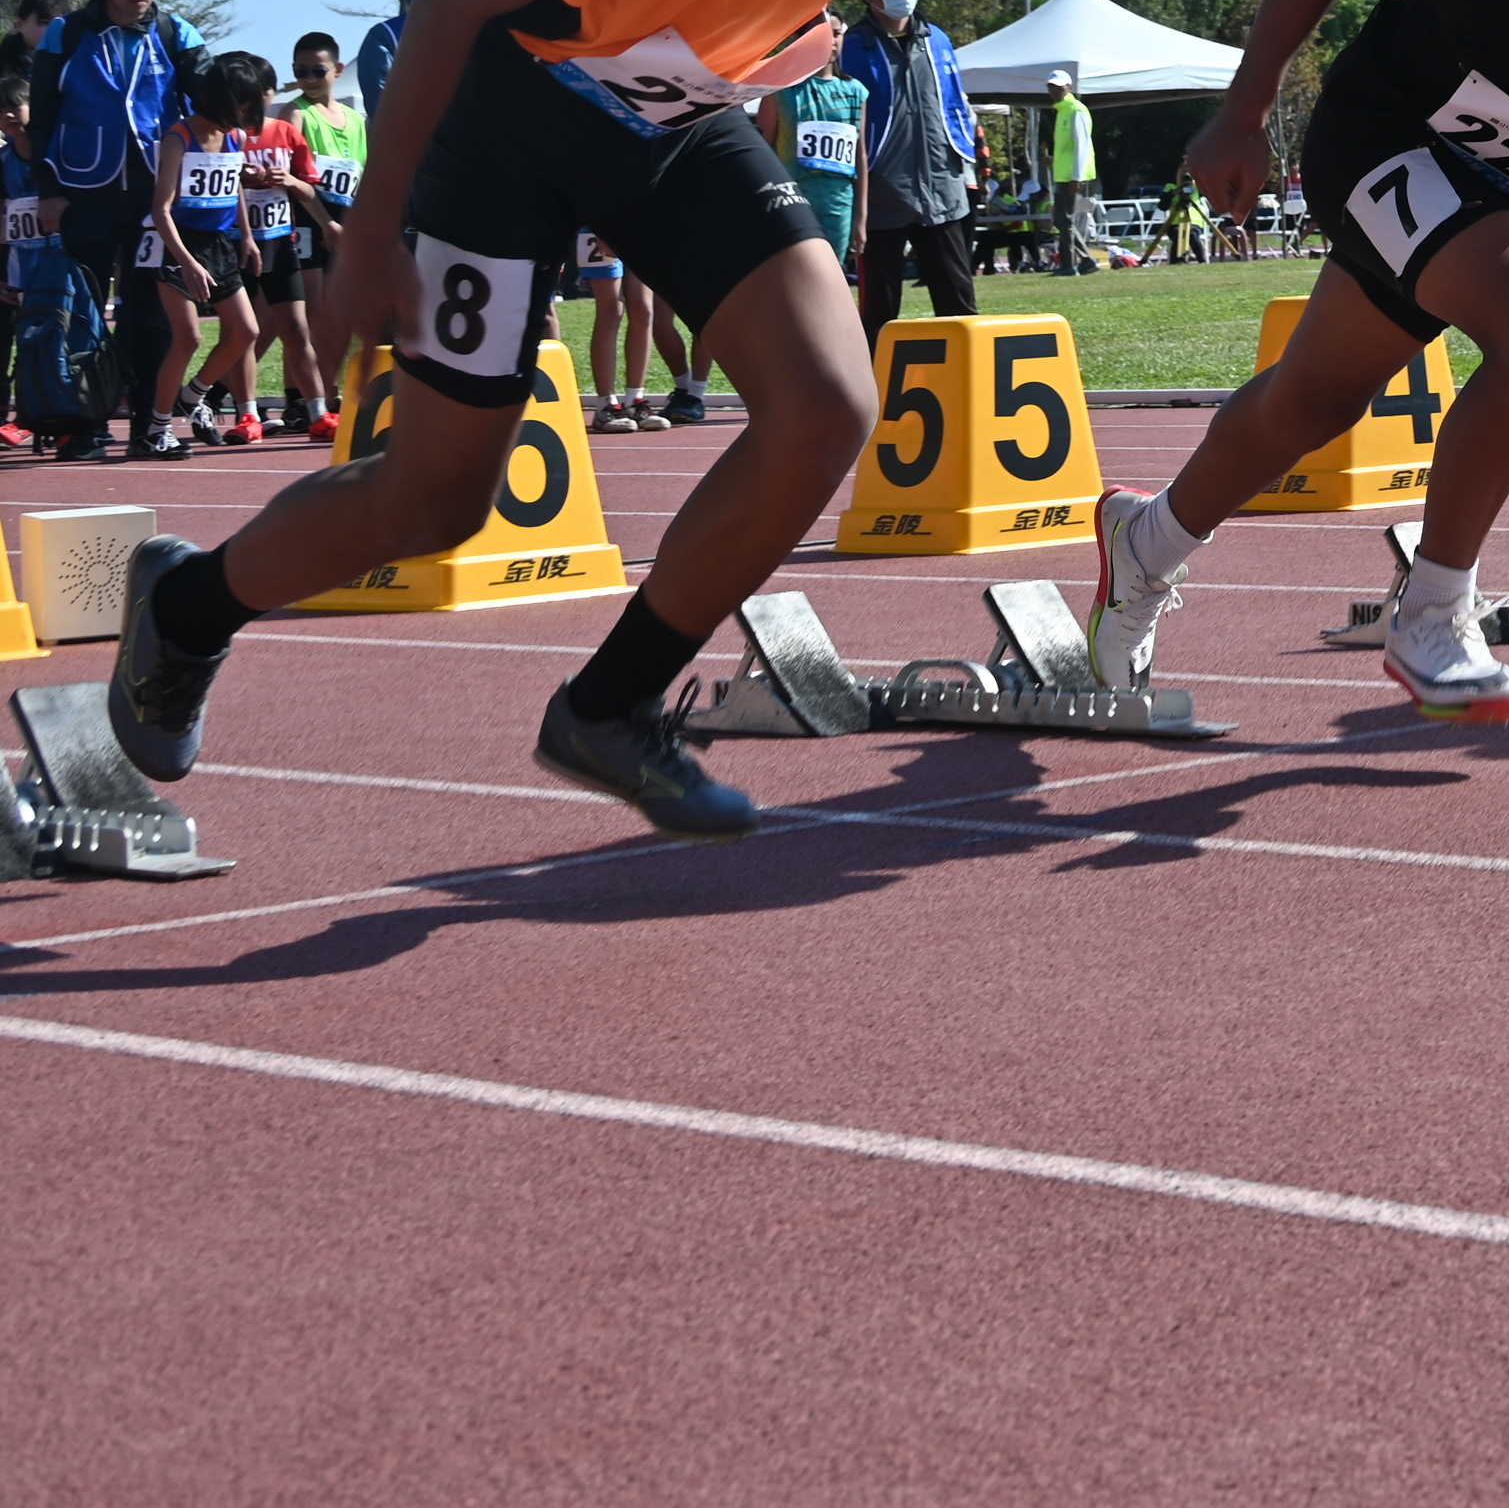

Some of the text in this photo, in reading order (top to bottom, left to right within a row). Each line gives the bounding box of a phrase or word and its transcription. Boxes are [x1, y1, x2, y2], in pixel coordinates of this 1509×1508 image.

[802, 133, 854, 164] 3003
[189, 169, 240, 197] 305
[1368, 165, 1421, 238] 7
[249, 200, 287, 229] 062
[138, 235, 153, 263] 3
[434, 263, 490, 356] 8
[877, 339, 947, 487] 5
[993, 333, 1071, 481] 5
[1371, 351, 1441, 444] 4
[494, 365, 570, 527] 6
[489, 554, 586, 586] 金陵
[1352, 603, 1383, 625] NIS
